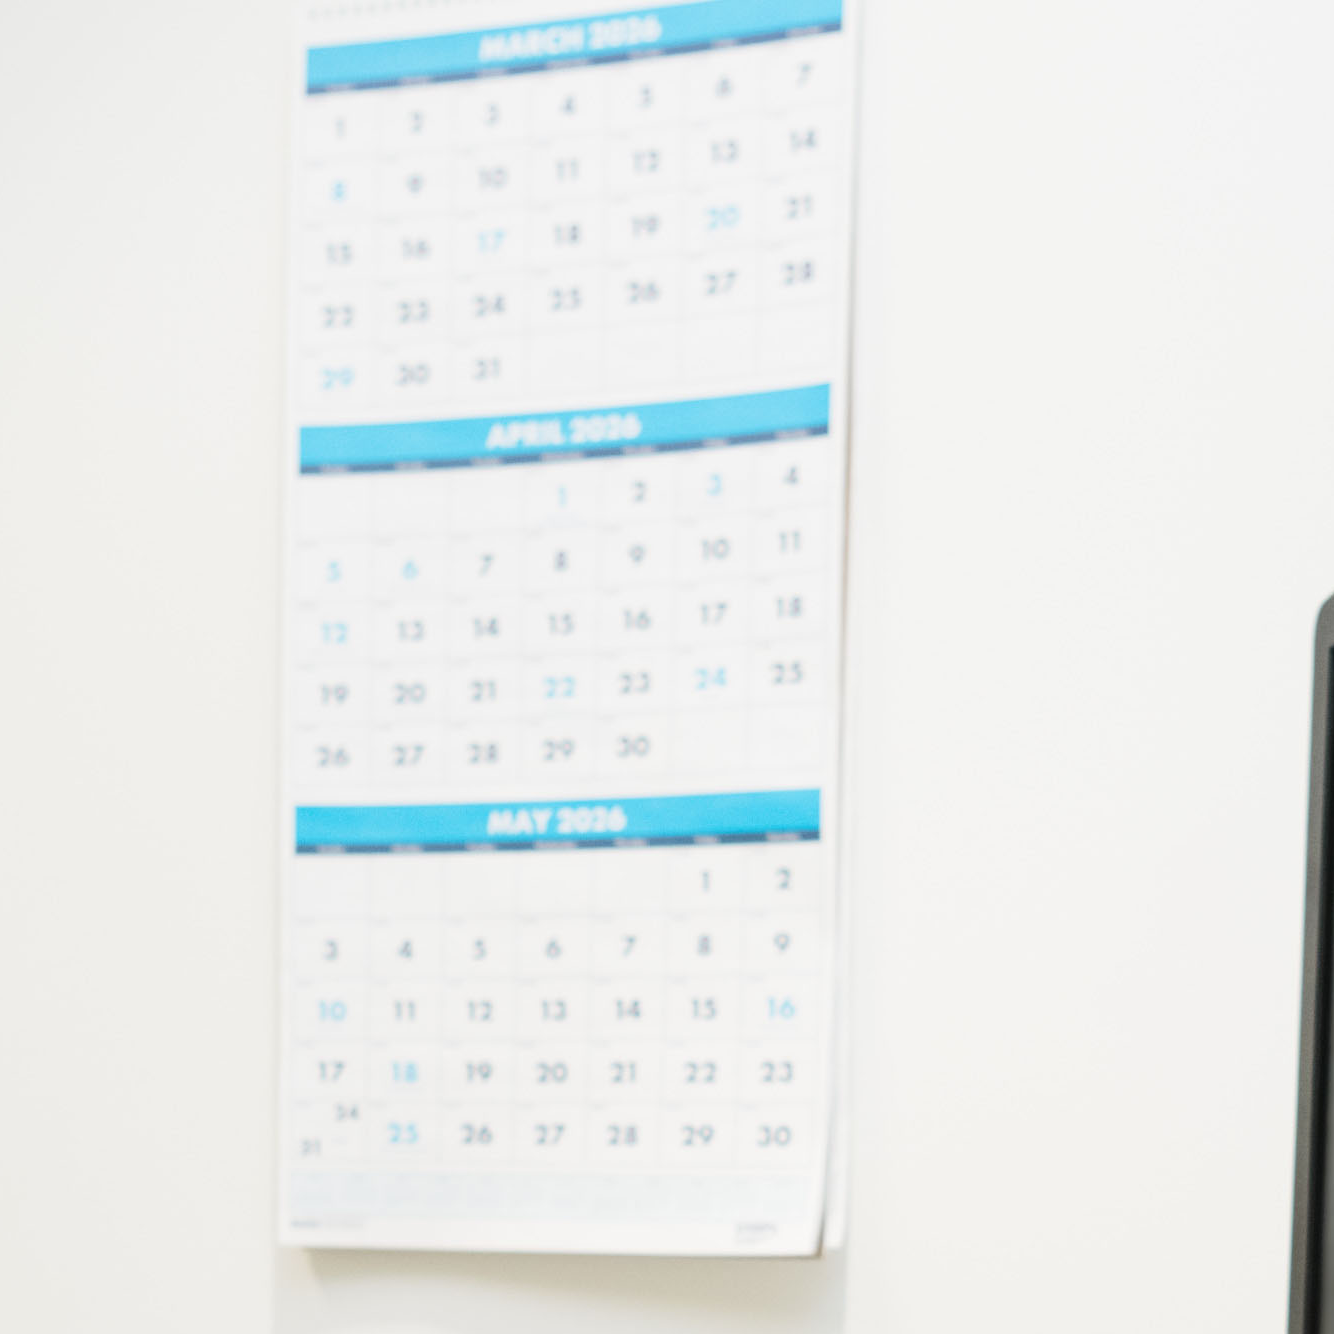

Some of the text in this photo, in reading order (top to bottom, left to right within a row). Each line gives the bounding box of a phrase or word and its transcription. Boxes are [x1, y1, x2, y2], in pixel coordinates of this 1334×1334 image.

[478, 15, 663, 62] MARCH 2026
[485, 412, 642, 450] APRIL 2026
[487, 805, 628, 836] MAY 2026
[776, 867, 793, 890] 2
[323, 932, 793, 962] 3 4 5 6 7 8 9
[318, 997, 797, 1023] 10 11 12 13 14 15 16
[318, 1060, 794, 1084] 17 18 19 20 21 22 23
[387, 1122, 419, 1145] 25
[461, 1123, 494, 1145] 26
[534, 1123, 566, 1146] 27
[607, 1124, 639, 1147] 28
[682, 1124, 715, 1147] 29
[757, 1124, 793, 1148] 30
